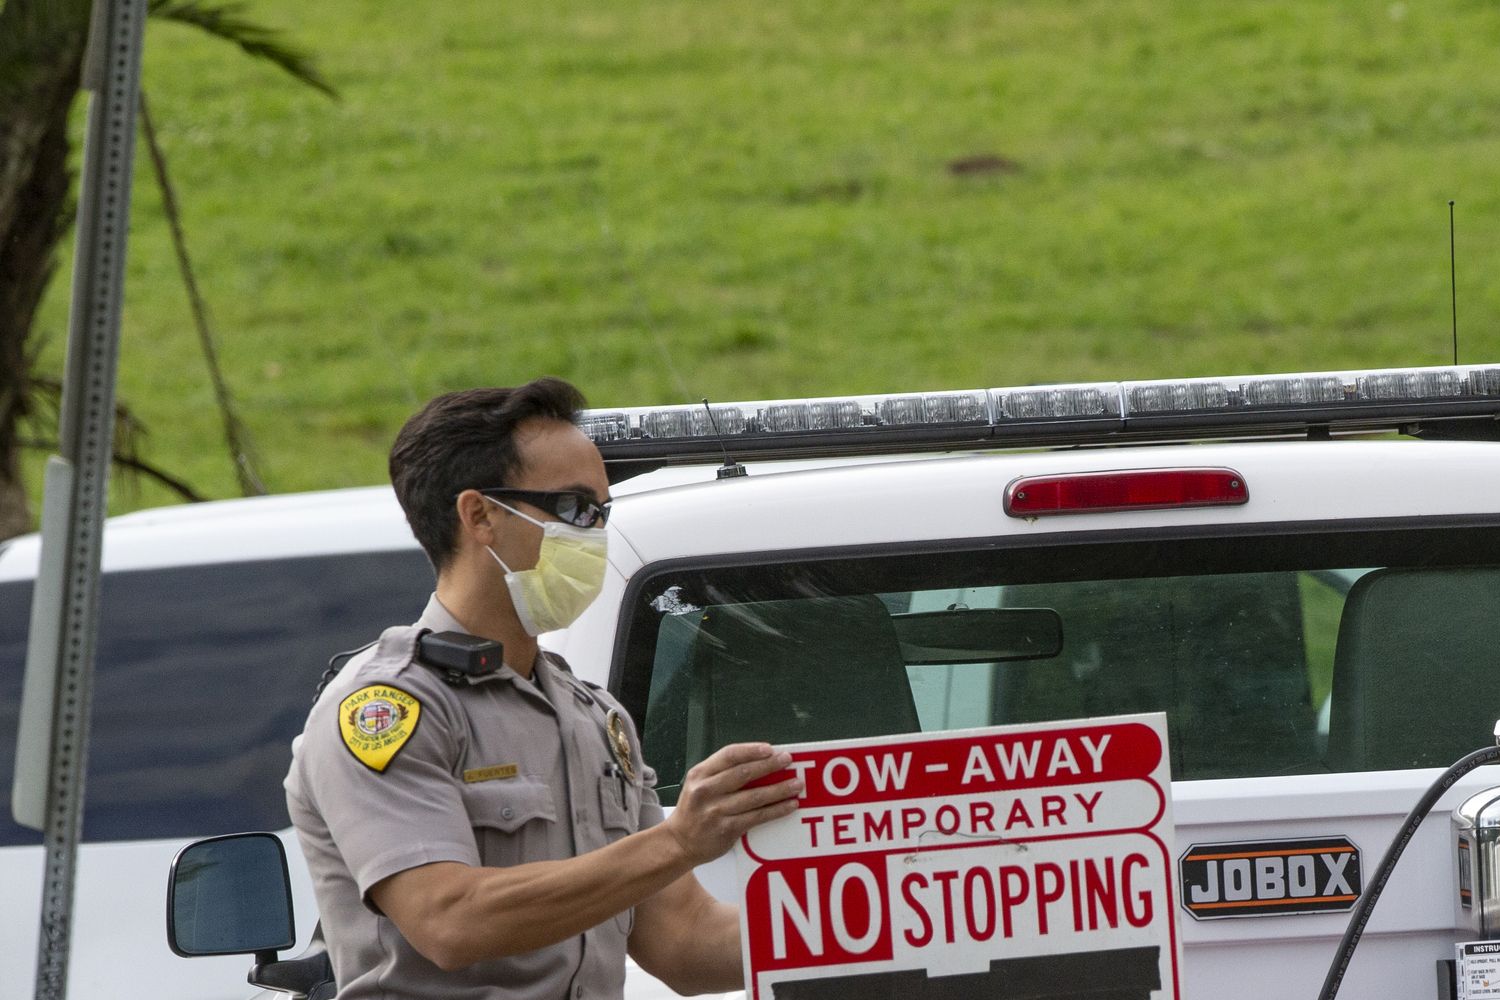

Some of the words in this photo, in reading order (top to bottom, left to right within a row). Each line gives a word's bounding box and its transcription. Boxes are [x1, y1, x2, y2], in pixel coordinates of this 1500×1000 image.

[344, 691, 369, 711] PARK
[374, 689, 416, 706] RANGER
[802, 791, 1104, 848] TEMPORARY
[1191, 853, 1354, 903] JOBOX
[767, 862, 883, 960] NO
[902, 853, 1154, 948] STOPPING
